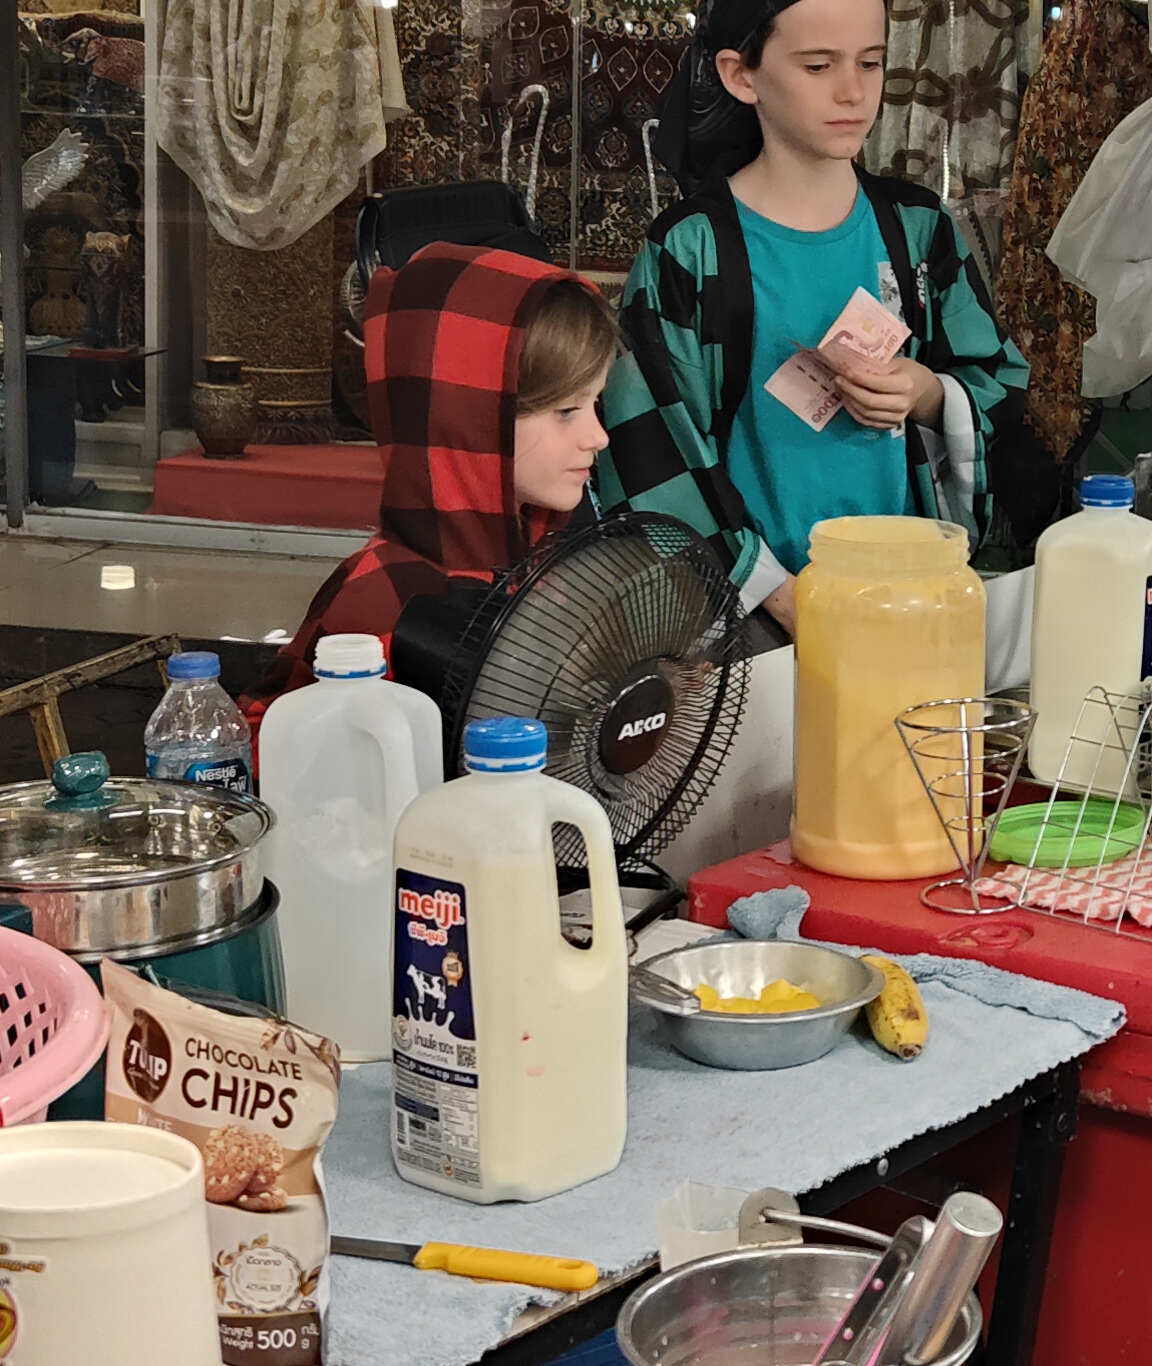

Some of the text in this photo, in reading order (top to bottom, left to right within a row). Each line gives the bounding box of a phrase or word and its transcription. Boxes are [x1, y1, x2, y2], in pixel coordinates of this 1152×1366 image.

[400, 888, 460, 928] meiji
[185, 1038, 303, 1080] CHOCOLATE
[222, 1336, 310, 1350] Weight g
[257, 1329, 297, 1349] 500
